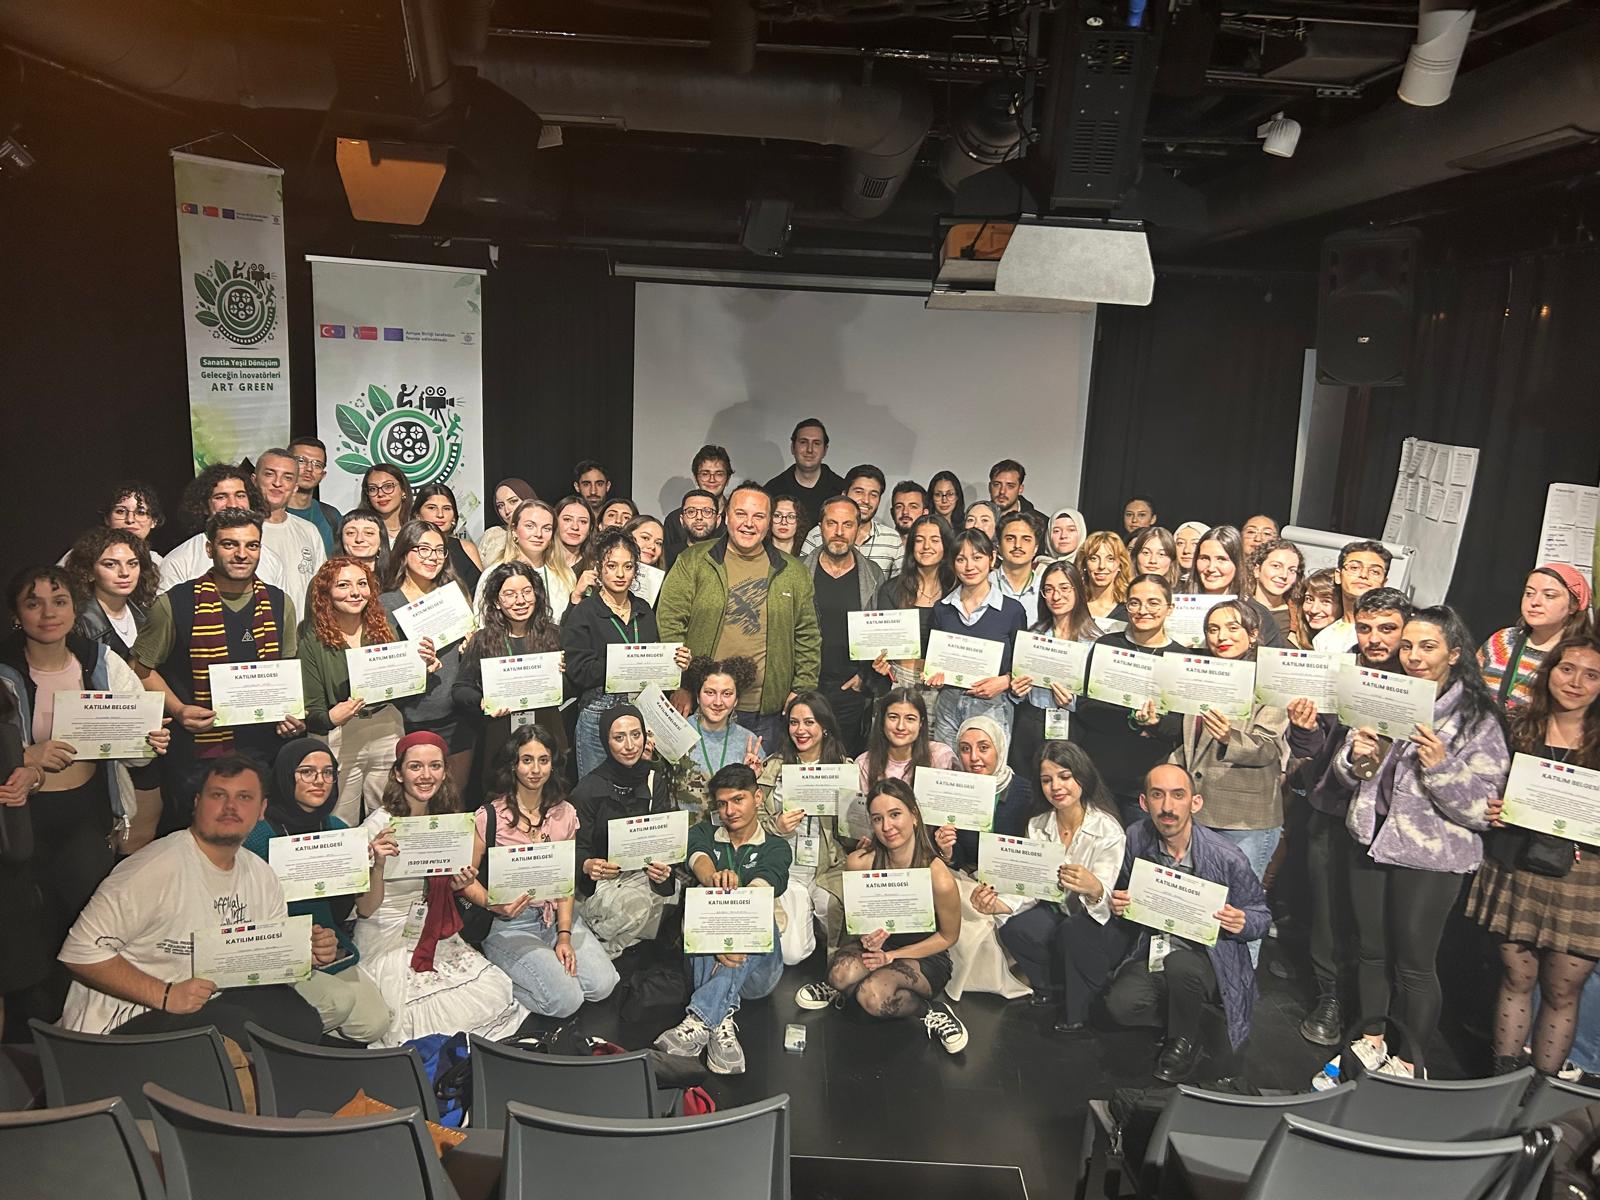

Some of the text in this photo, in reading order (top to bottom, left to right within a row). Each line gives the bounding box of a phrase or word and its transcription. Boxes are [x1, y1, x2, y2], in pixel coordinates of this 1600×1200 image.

[230, 359, 247, 367] Yeşil
[248, 359, 278, 368] Dönüşüm
[201, 370, 281, 380] Geleceğin İnovatörleri
[211, 382, 274, 391] ART GREEN
[1362, 681, 1385, 690] KATILIM
[1542, 773, 1571, 784] KATILIM
[225, 932, 283, 945] KATILIM BELGESİ
